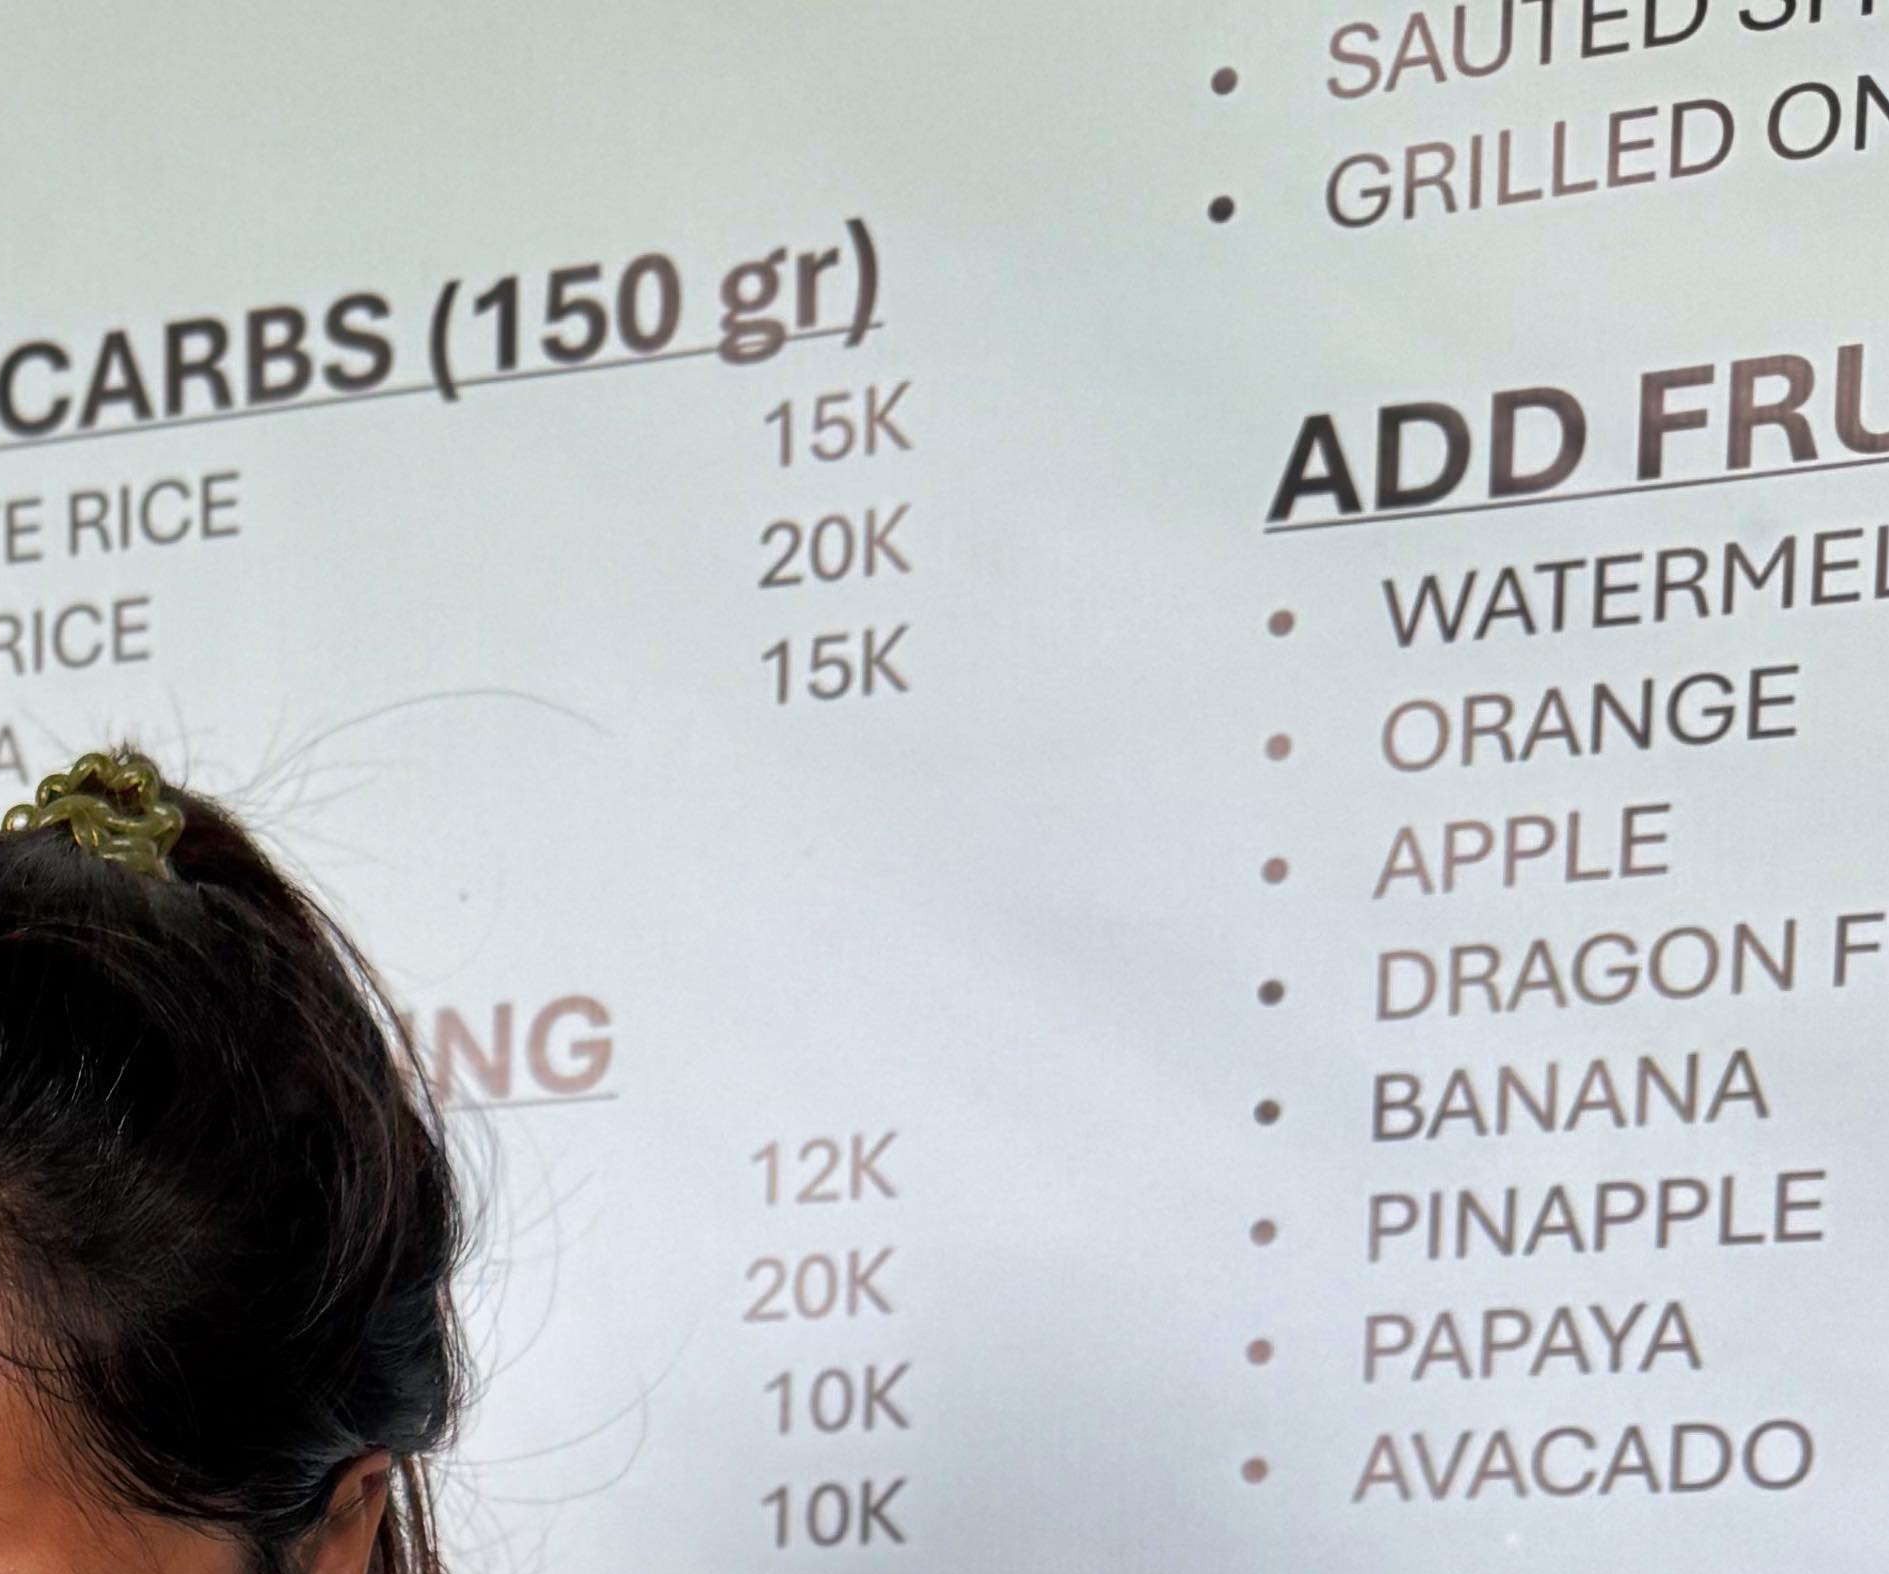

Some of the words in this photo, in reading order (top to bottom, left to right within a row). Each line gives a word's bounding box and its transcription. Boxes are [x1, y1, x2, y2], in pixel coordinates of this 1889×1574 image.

[1326, 0, 1708, 99] SAUTED
[1325, 99, 1736, 229] GRILLED
[429, 253, 682, 402] (150
[718, 216, 879, 366] gr)
[762, 379, 913, 469] 15K
[1265, 386, 1587, 524] ADD
[67, 469, 241, 558] RICE
[757, 503, 911, 590] 20K
[761, 623, 910, 705] 15K
[1381, 663, 1800, 773] ORANGE
[1372, 802, 1673, 900] APPLE
[1376, 917, 1798, 1022] DRAGON
[1832, 911, 1887, 988] F
[1371, 1047, 1771, 1143] BANANA
[750, 1129, 899, 1207] 12K
[1367, 1169, 1827, 1263] PINAPPLE
[741, 1245, 895, 1324] 20K
[1363, 1300, 1704, 1384] PAPAYA
[764, 1360, 911, 1436] 10K
[1351, 1418, 1815, 1505] AVACADO
[761, 1476, 908, 1549] 10K
